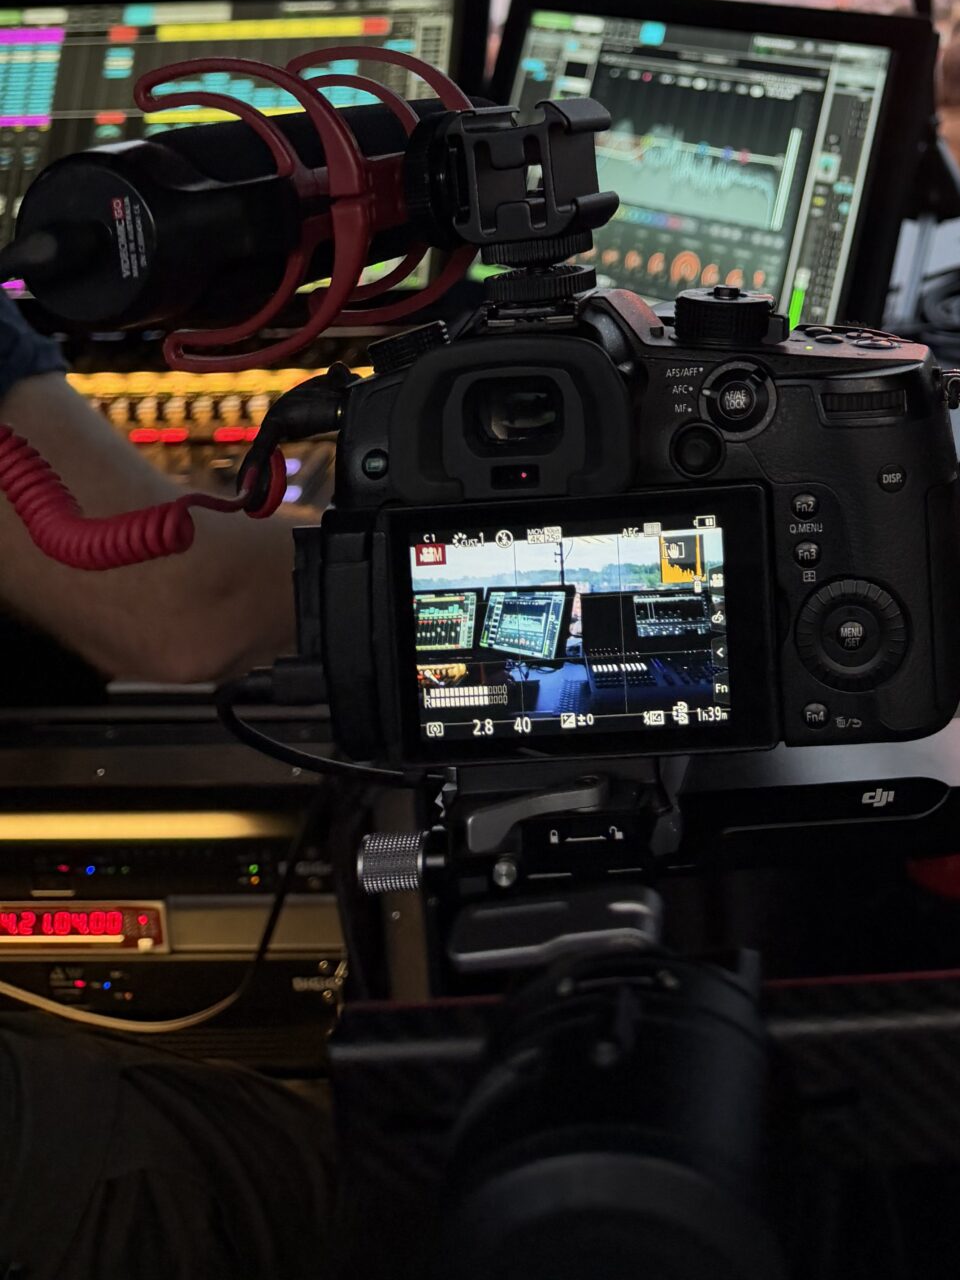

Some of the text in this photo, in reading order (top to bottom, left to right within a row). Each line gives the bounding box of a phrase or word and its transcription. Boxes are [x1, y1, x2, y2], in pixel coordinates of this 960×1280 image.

[113, 200, 123, 219] GO
[666, 367, 698, 378] AFS/AFF
[672, 385, 688, 394] AFC
[724, 390, 747, 400] AF/AE
[674, 404, 687, 413] MF
[725, 400, 746, 410] LOCK
[882, 473, 903, 484] DISP.
[795, 501, 814, 512] Fn2
[526, 528, 545, 536] MOV
[621, 527, 639, 538] AFC
[789, 523, 823, 534] Q.MENU
[798, 548, 816, 560] Fn3
[840, 627, 863, 638] MENU
[844, 637, 860, 647] /SET
[424, 688, 431, 698] L
[715, 683, 728, 693] Fn
[424, 698, 431, 708] R
[472, 718, 494, 736] 2.8
[514, 716, 531, 733] 40
[697, 706, 728, 722] 1h39m
[806, 711, 825, 722] Fn4
[861, 788, 895, 807] dji
